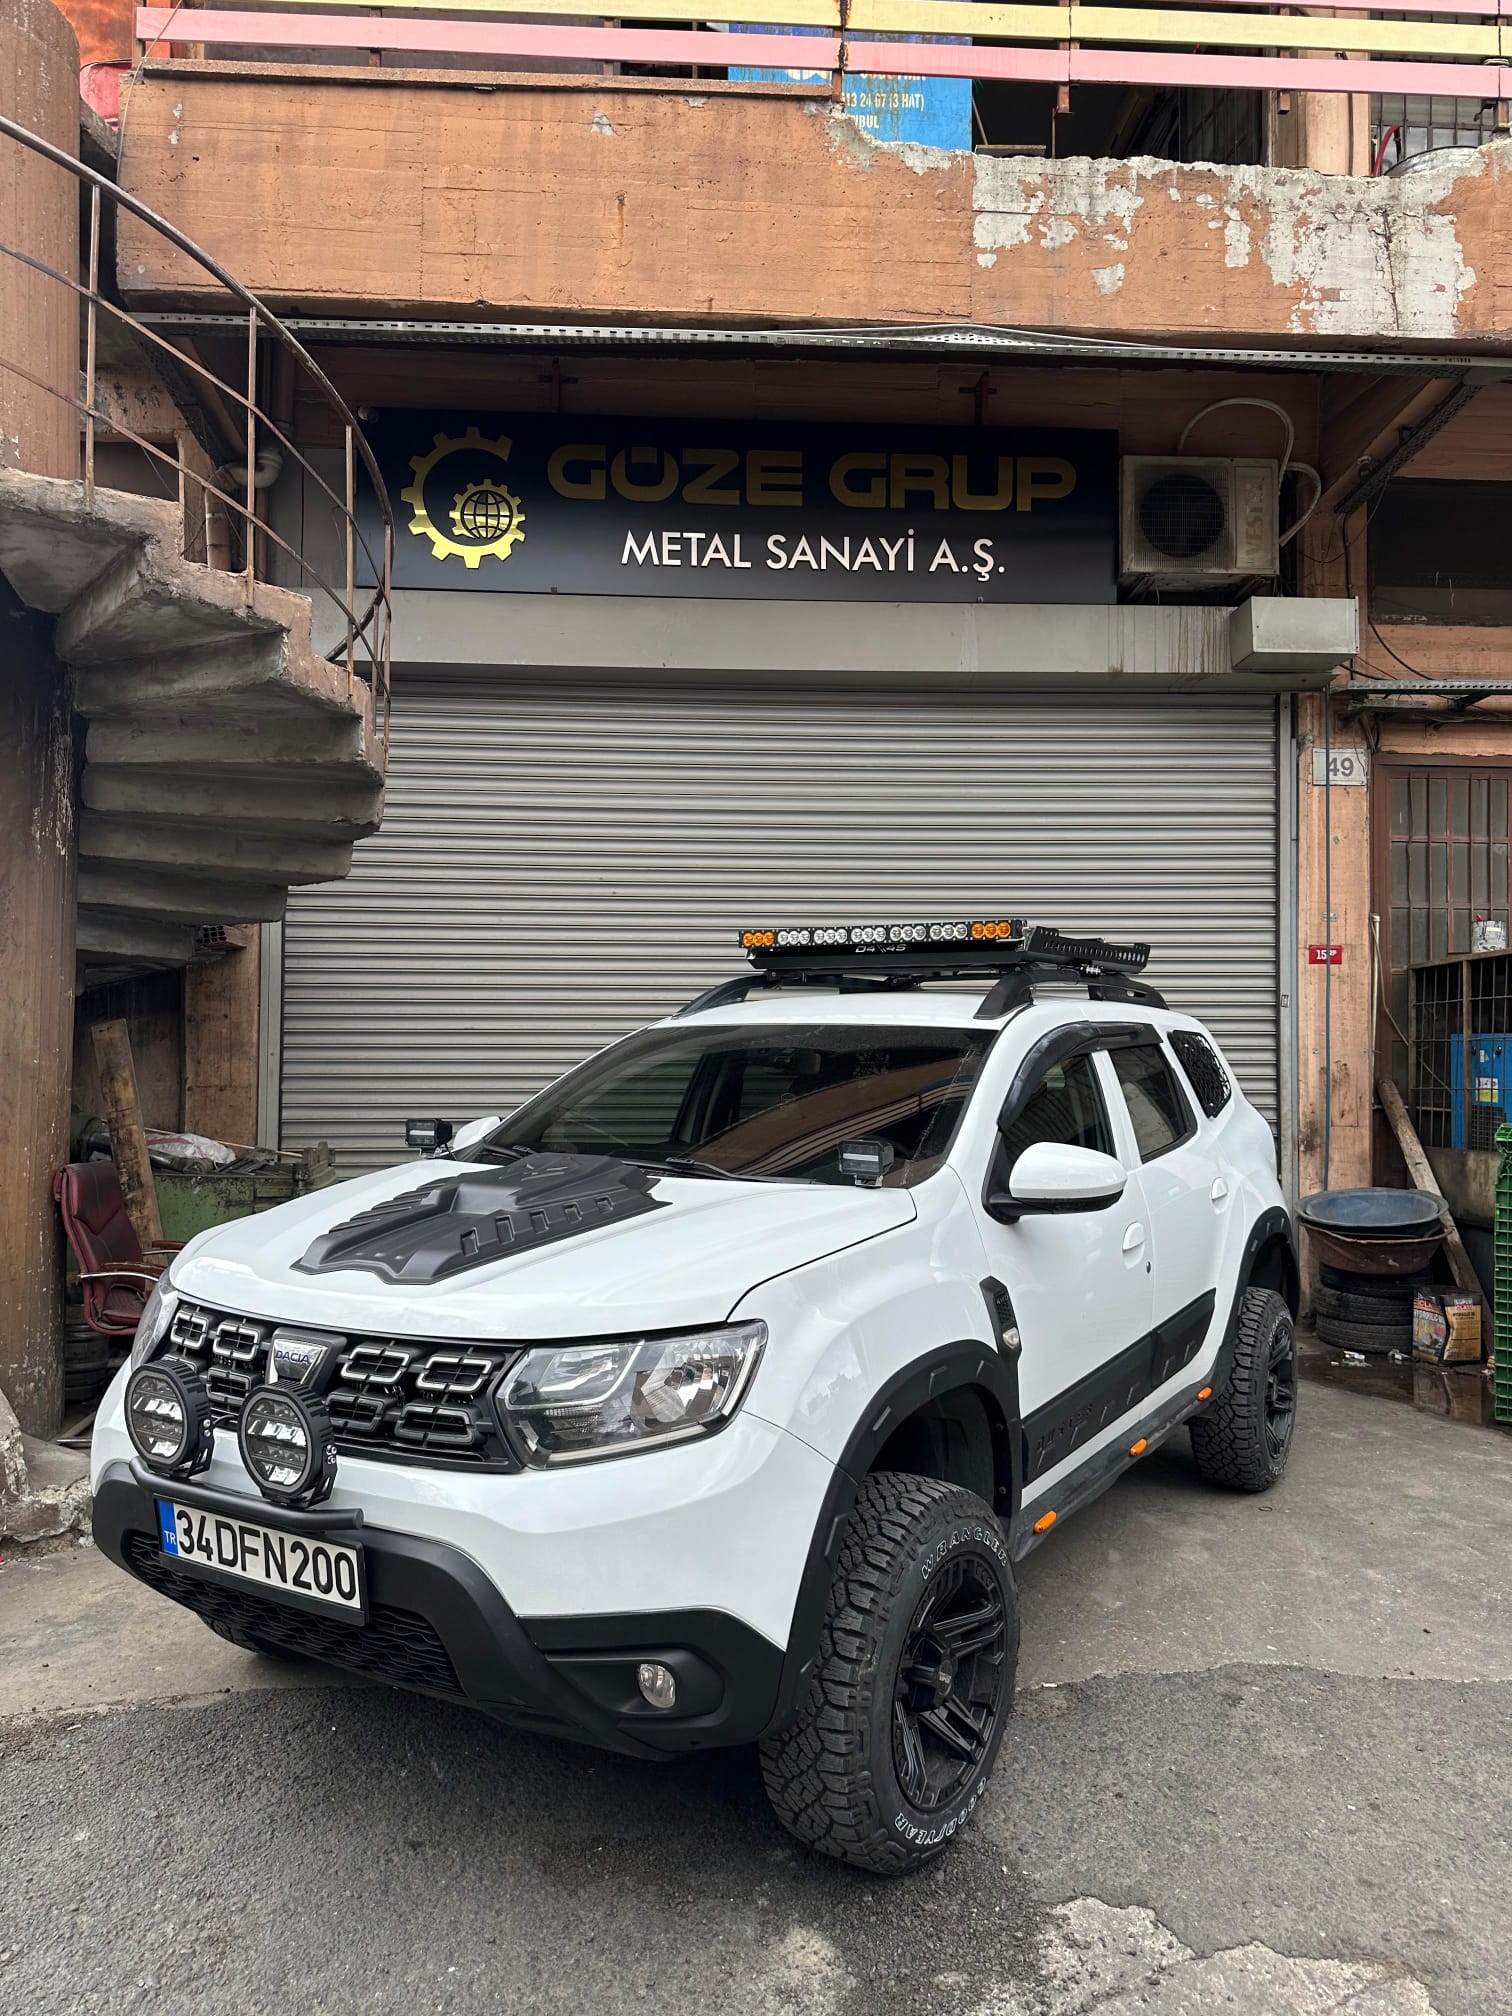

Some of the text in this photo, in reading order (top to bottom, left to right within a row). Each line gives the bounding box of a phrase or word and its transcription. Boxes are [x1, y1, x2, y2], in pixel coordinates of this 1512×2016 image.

[901, 93, 925, 112] HAT)
[828, 452, 1077, 512] GRUP
[620, 528, 1006, 581] METAL SANAYİ A.Ş.
[1327, 756, 1355, 777] 49
[1316, 949, 1327, 960] 15
[275, 1350, 312, 1365] DACIA
[163, 1530, 177, 1546] TR
[921, 1526, 1008, 1580] WRANGLER
[894, 1777, 987, 1845] GOODYEAR
